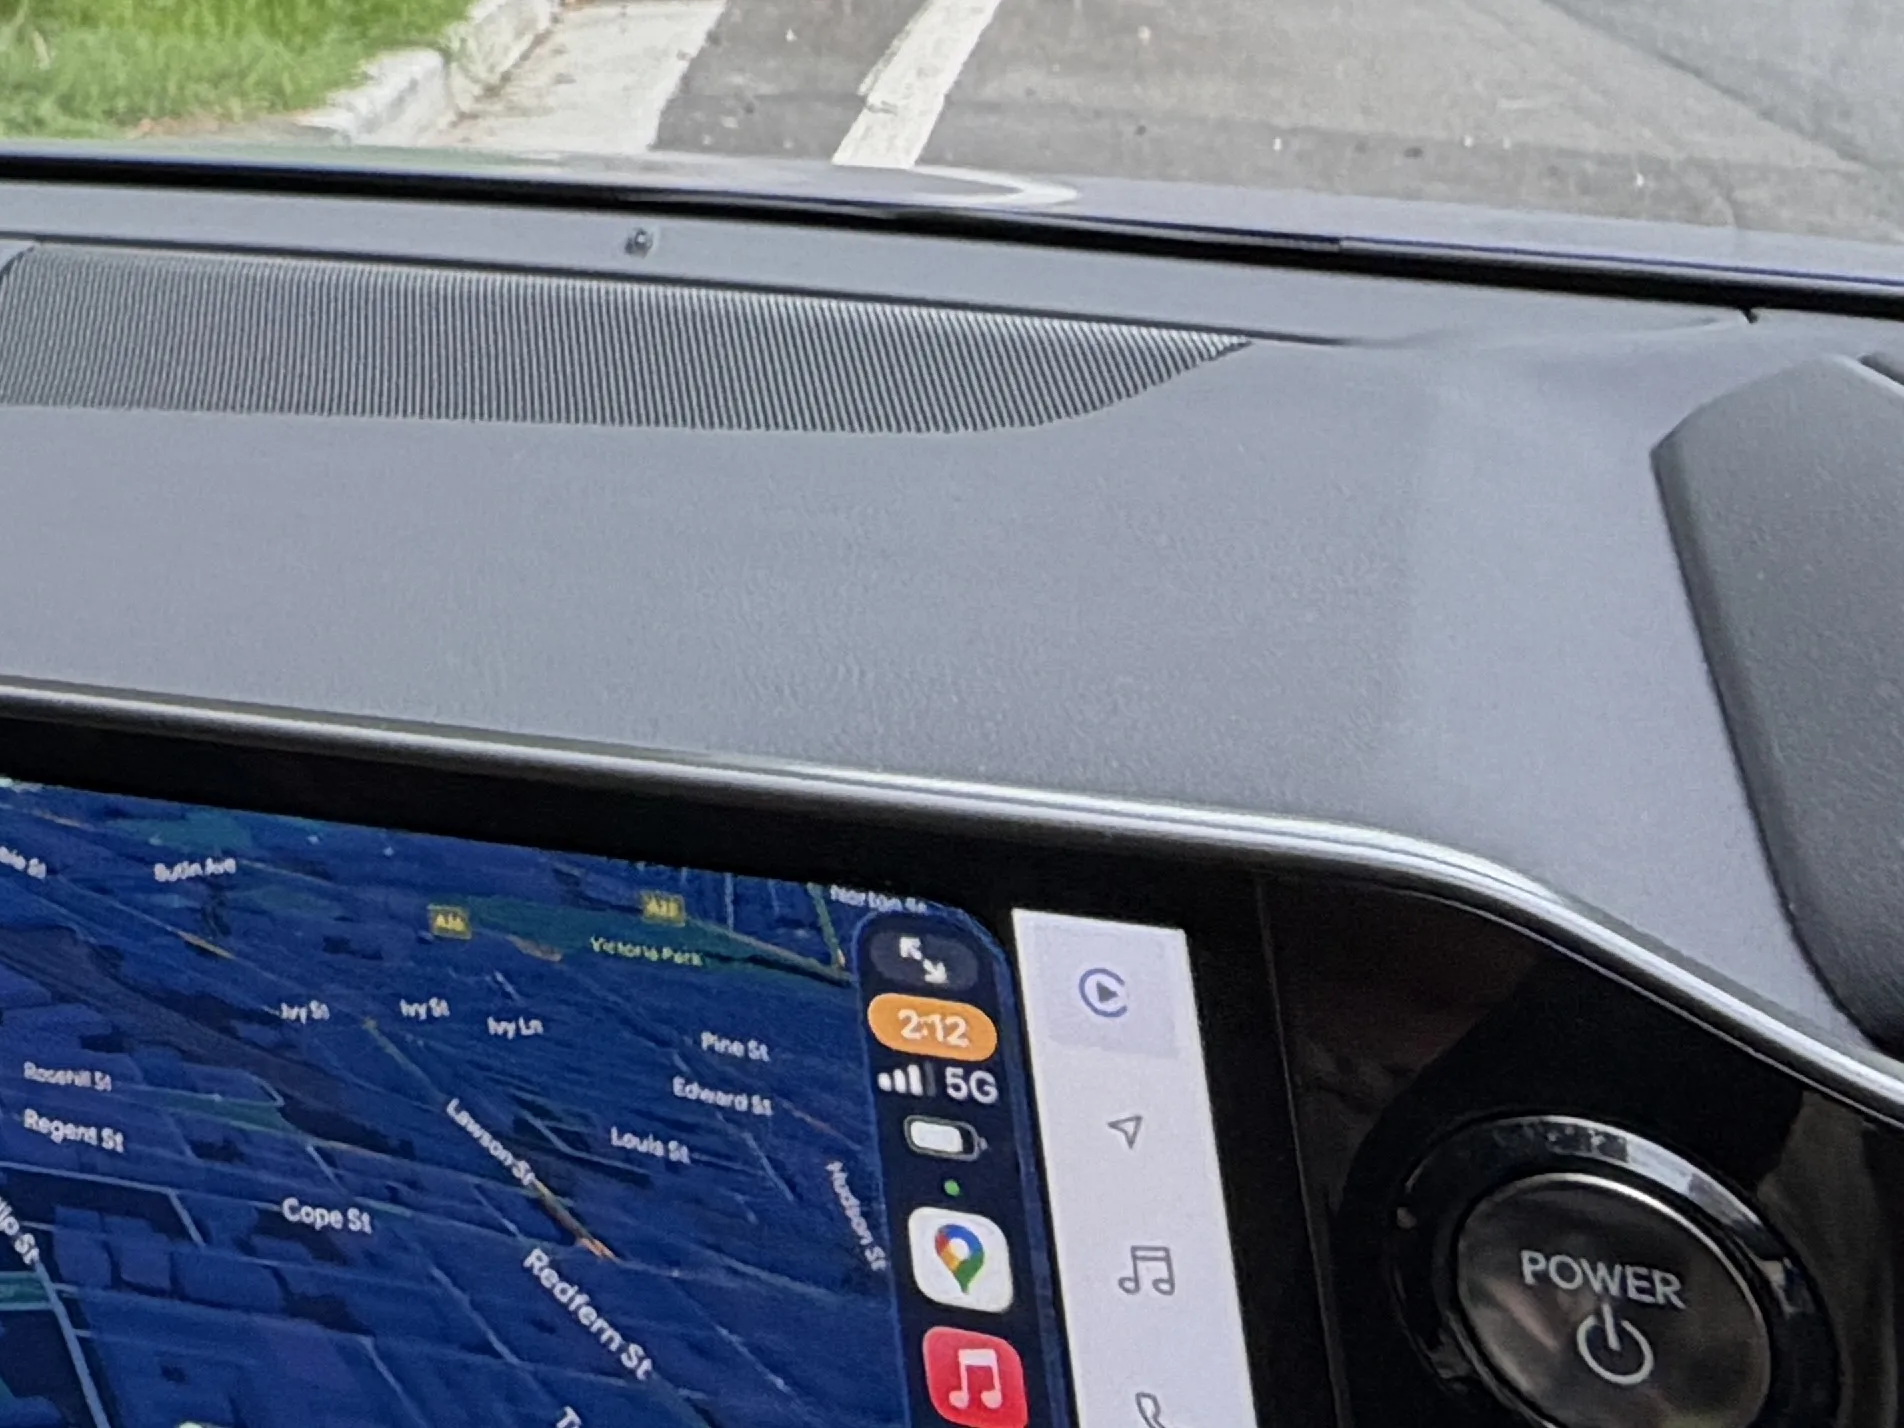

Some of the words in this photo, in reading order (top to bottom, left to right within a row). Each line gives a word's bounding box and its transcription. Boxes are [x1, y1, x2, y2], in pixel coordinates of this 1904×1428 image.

[897, 1008, 970, 1049] 2:12
[945, 1066, 999, 1105] 5G
[100, 1127, 125, 1154] St
[282, 1197, 344, 1231] Cope
[347, 1206, 373, 1235] St
[14, 1232, 40, 1265] St
[864, 1245, 887, 1272] St
[1520, 1249, 1686, 1309] POWER
[523, 1247, 623, 1352] Redfern
[620, 1343, 653, 1380] St
